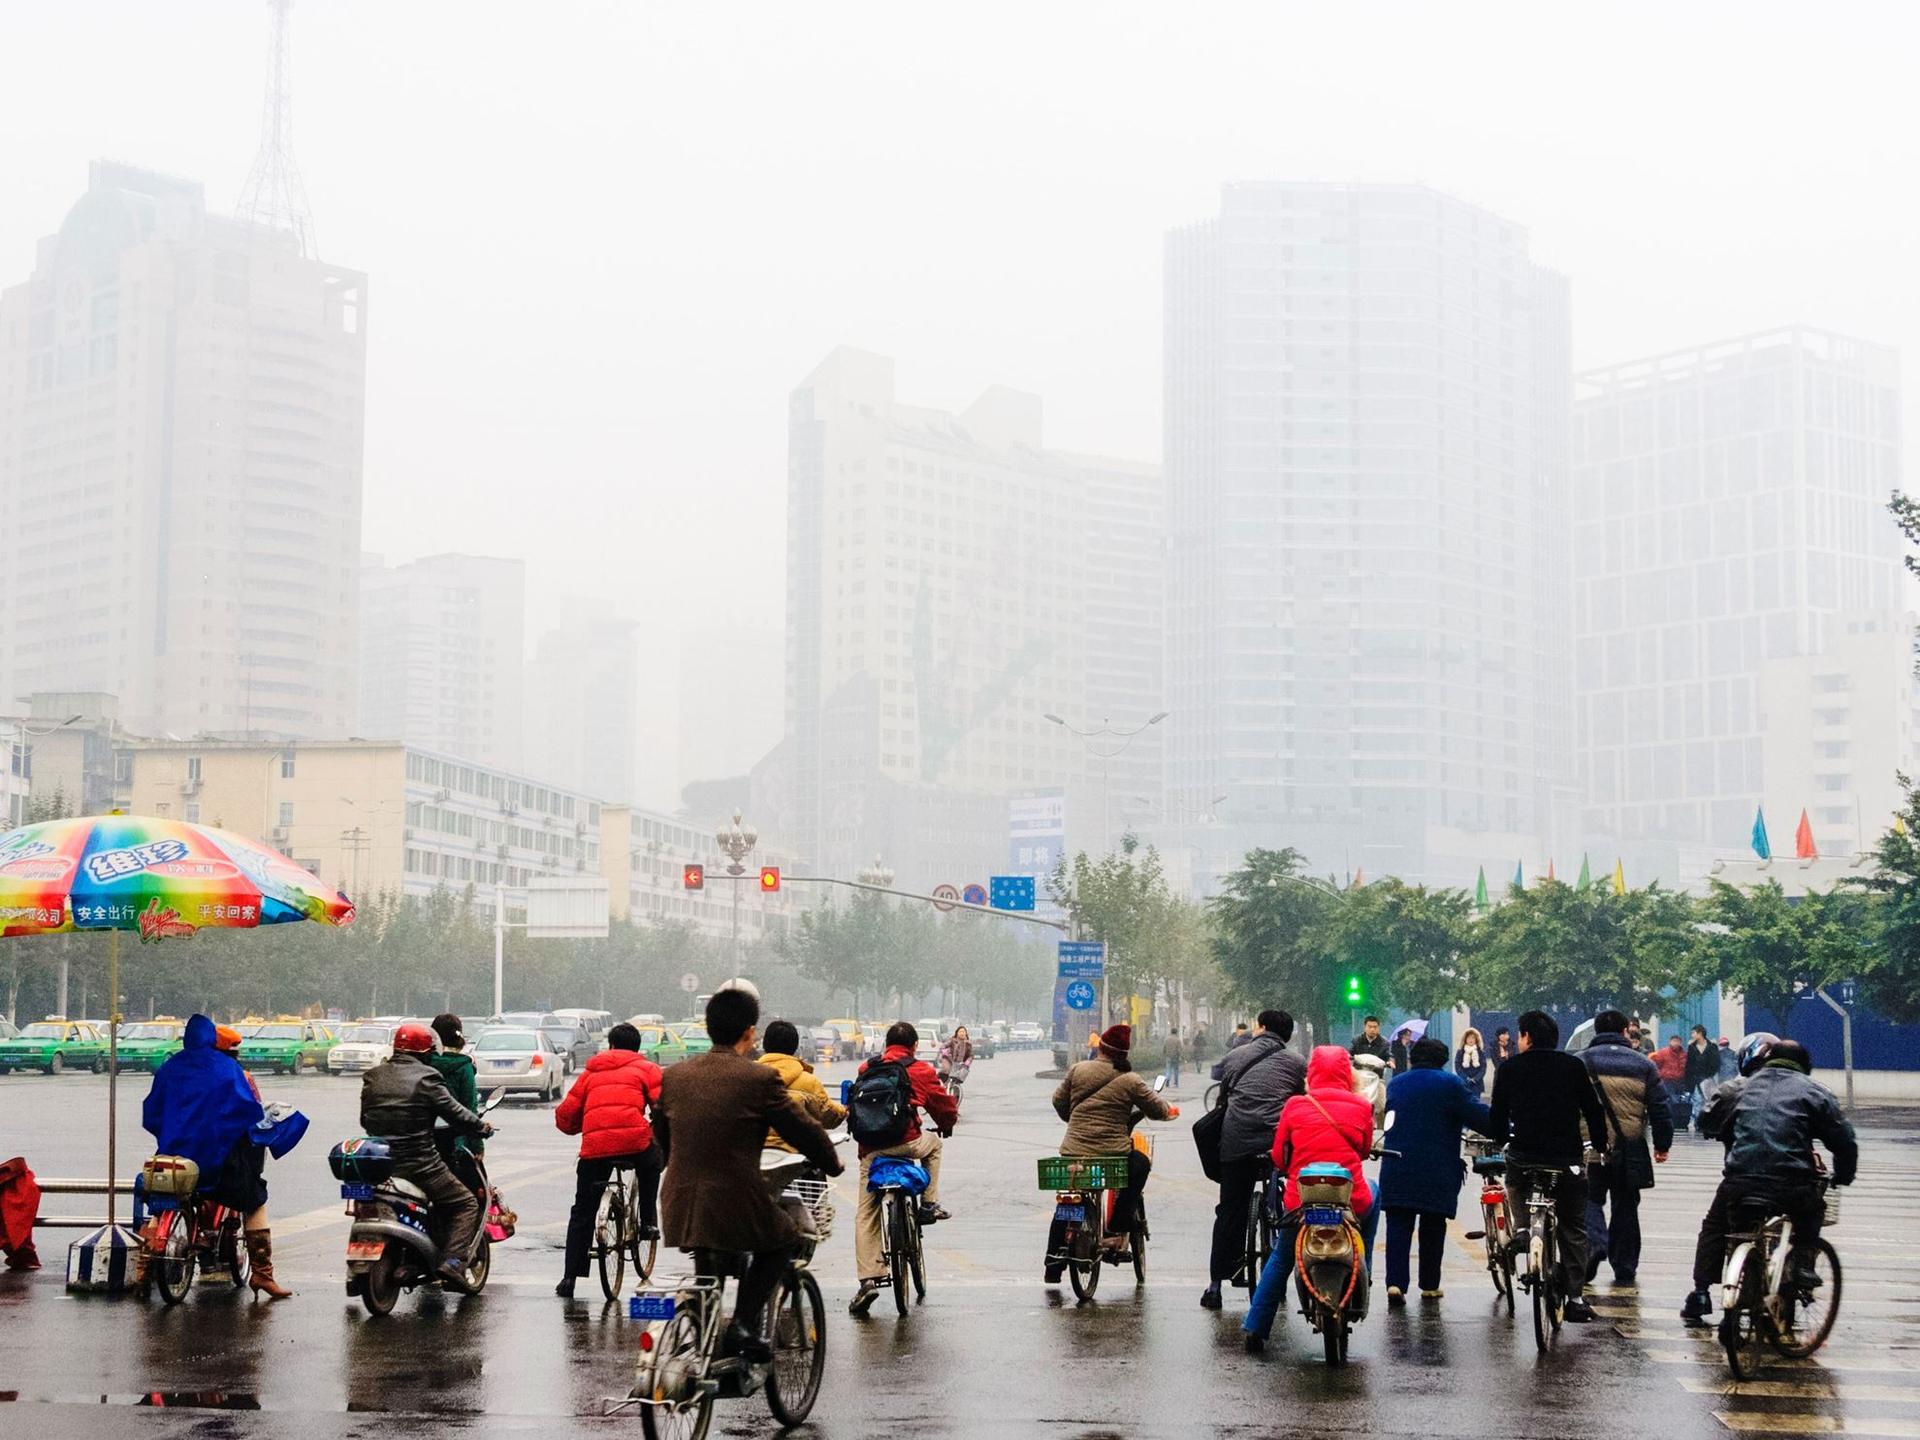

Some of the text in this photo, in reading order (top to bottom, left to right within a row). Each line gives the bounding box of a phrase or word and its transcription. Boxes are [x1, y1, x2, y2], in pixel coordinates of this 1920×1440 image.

[78, 905, 136, 921] 安全出行
[199, 904, 255, 920] 平安回家
